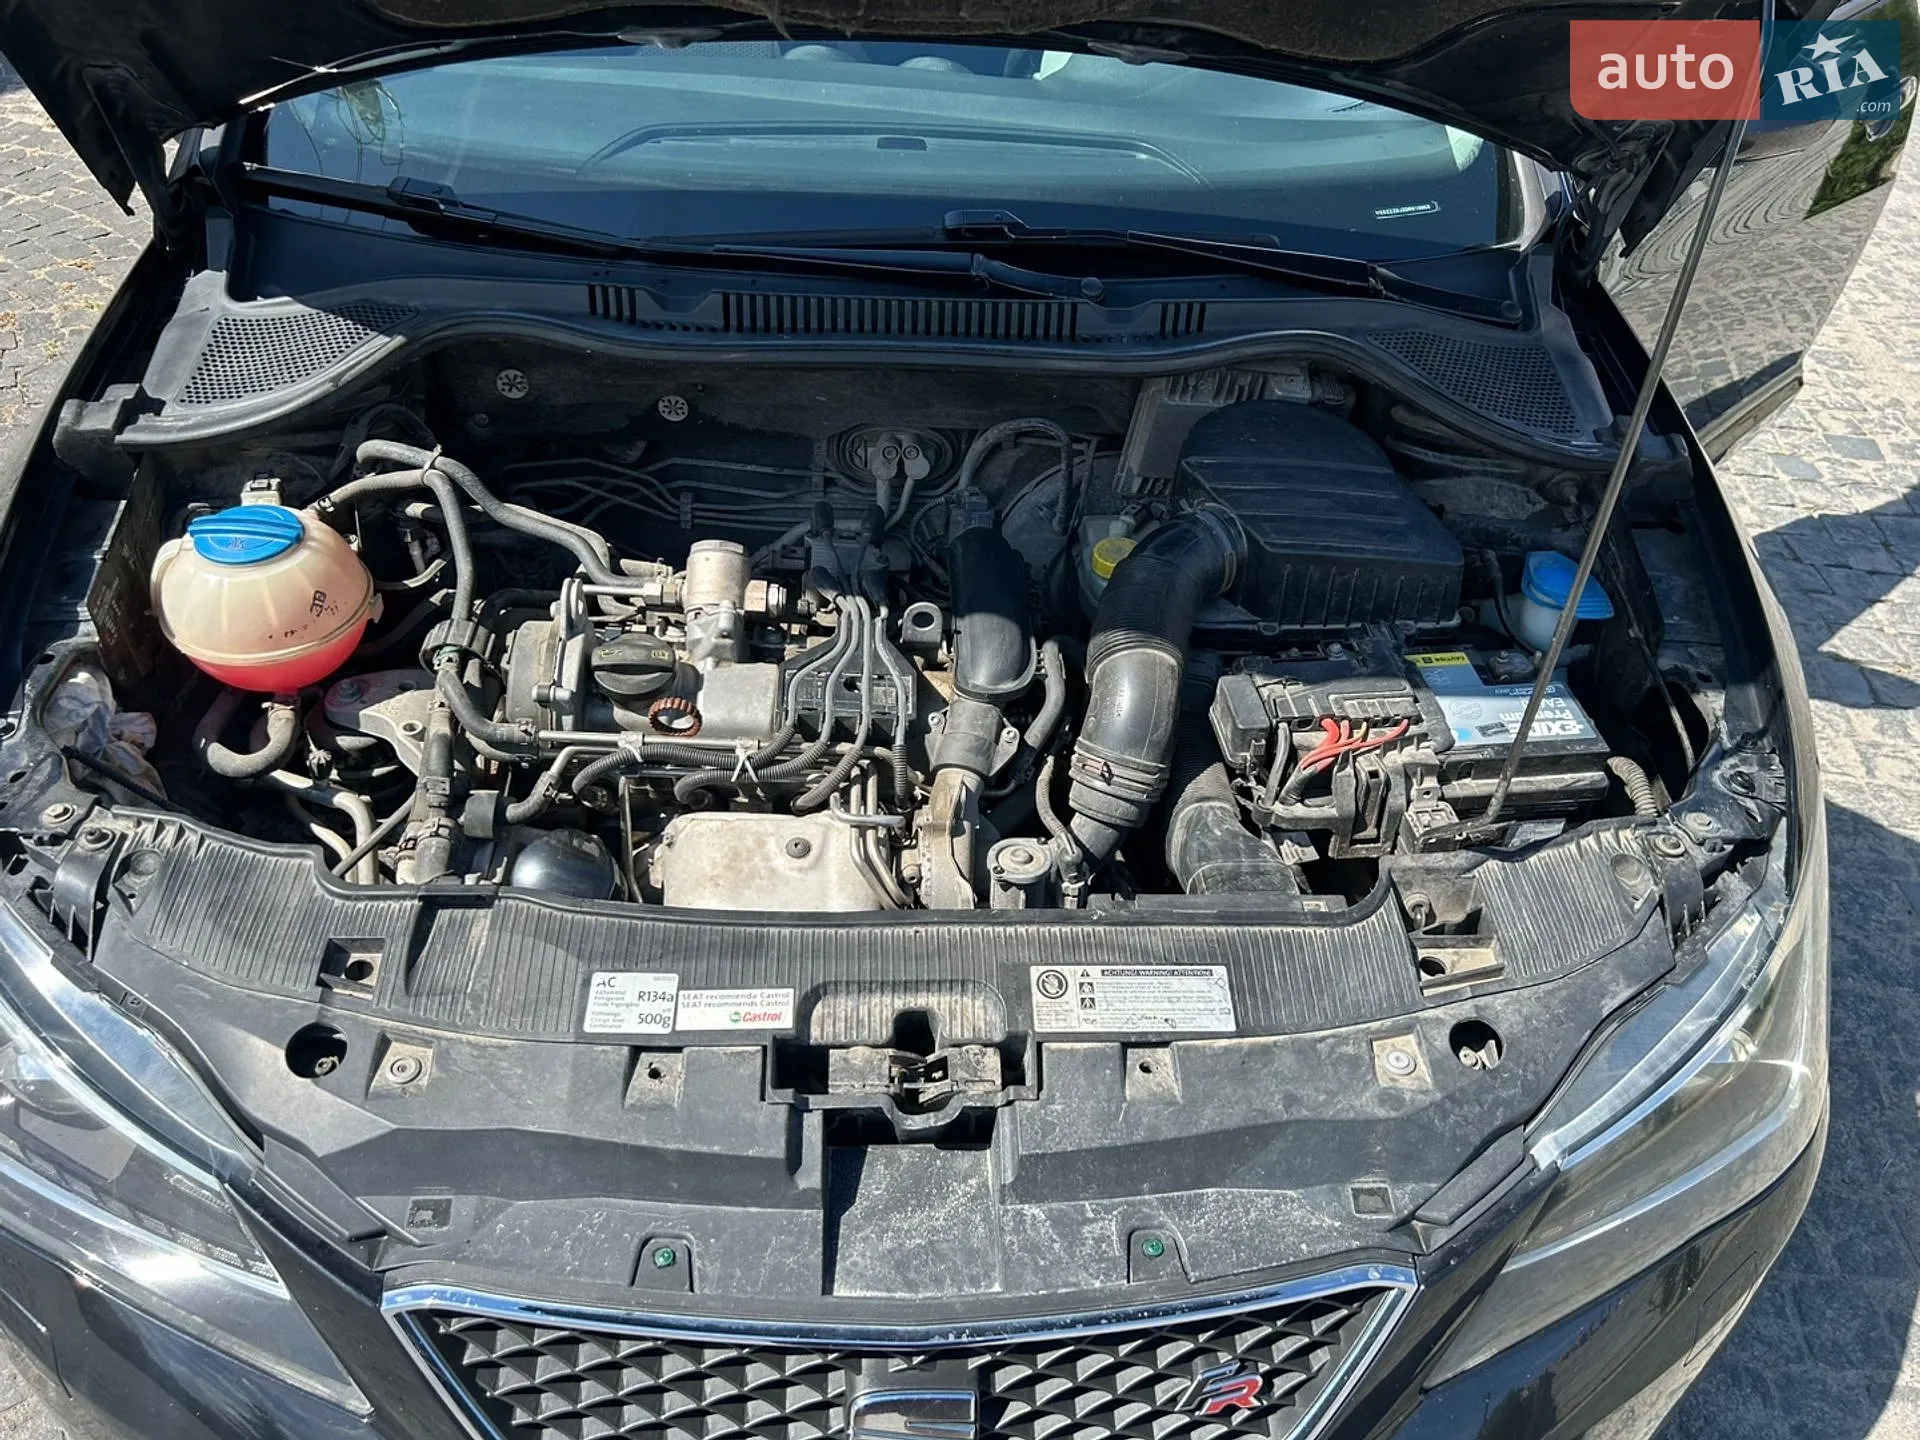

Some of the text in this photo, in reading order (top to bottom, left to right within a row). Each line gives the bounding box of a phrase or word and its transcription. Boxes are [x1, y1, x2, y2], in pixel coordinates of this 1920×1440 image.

[596, 976, 617, 988] AC
[637, 990, 675, 1003] R134a
[682, 993, 703, 1001] SEAT
[760, 991, 790, 999] Castrol
[681, 1001, 702, 1009] SEAT
[760, 999, 789, 1007] Castrol
[638, 1013, 671, 1029] 500g
[742, 1011, 782, 1023] Castrol
